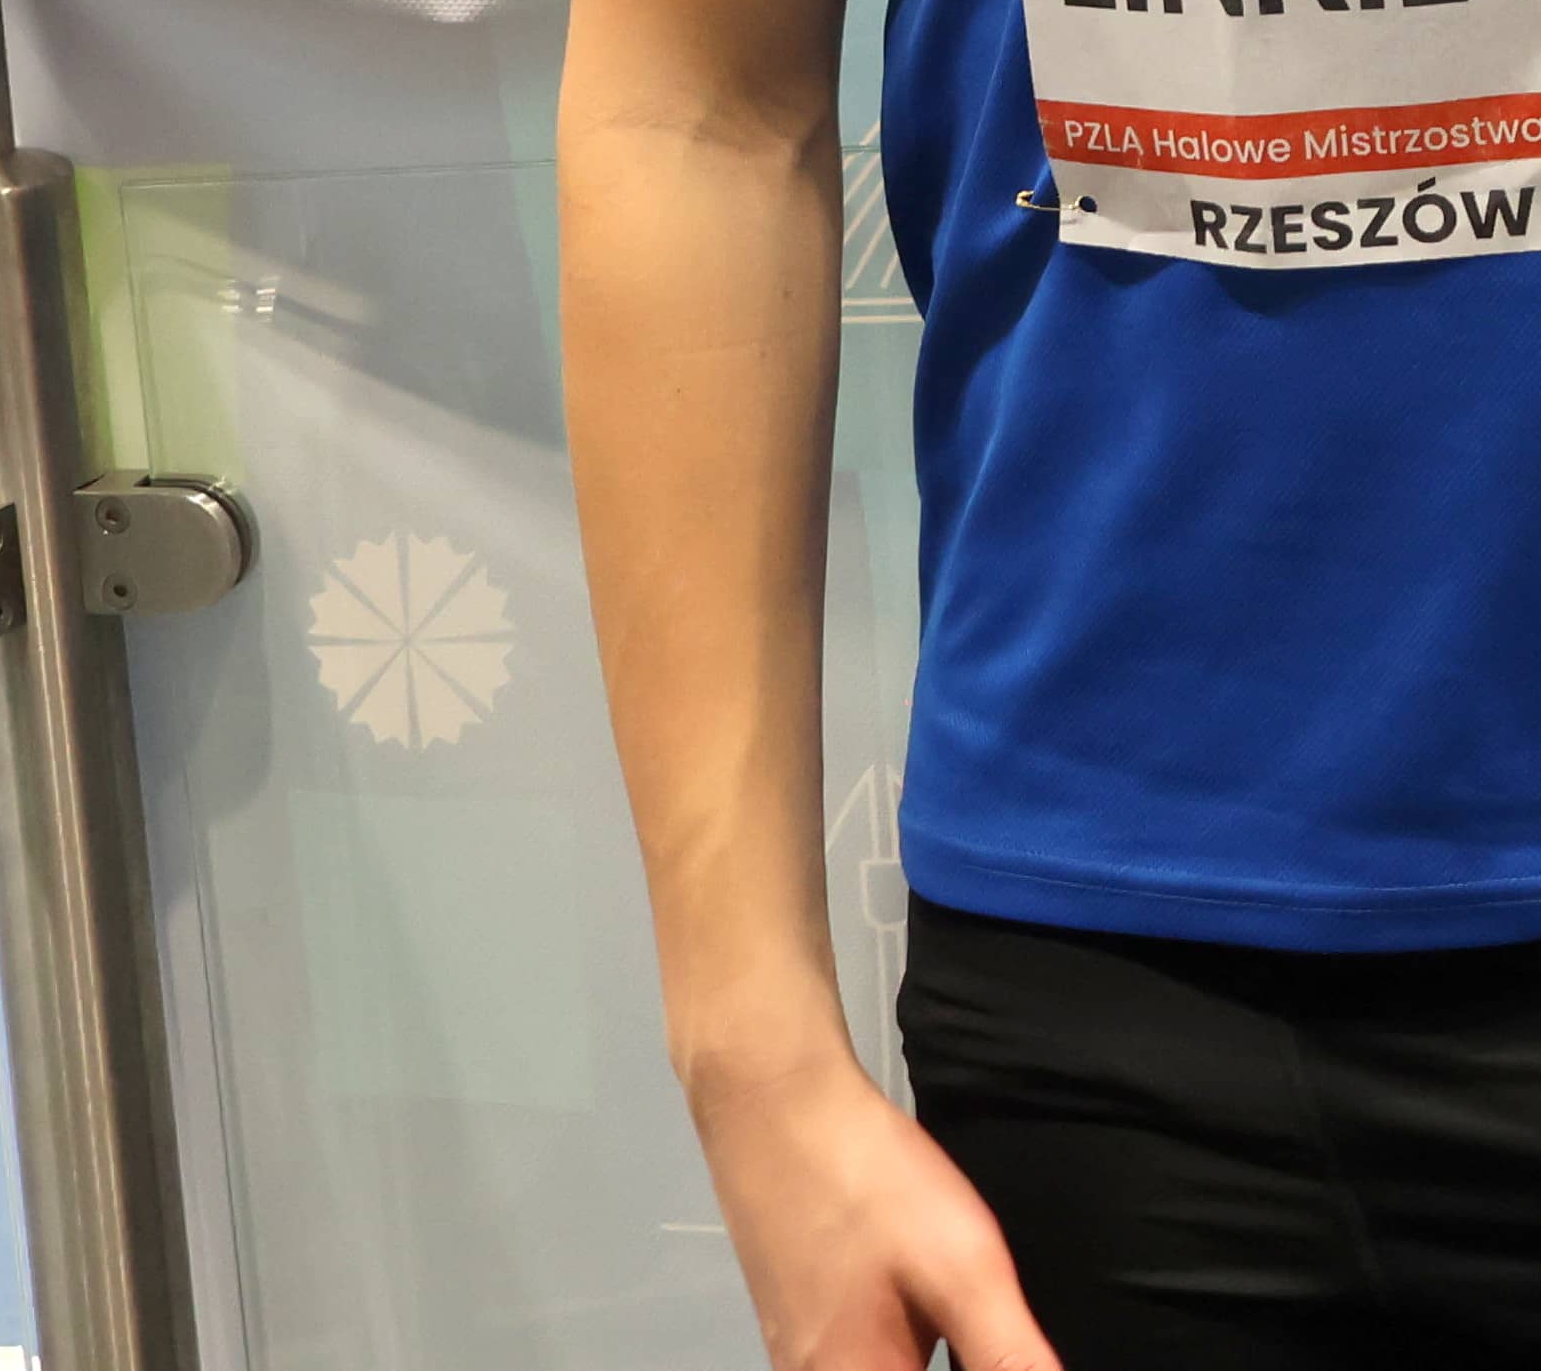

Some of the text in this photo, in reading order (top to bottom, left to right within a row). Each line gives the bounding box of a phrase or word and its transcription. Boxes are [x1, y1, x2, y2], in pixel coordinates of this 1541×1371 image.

[1064, 120, 1144, 155] PZLA
[1153, 128, 1291, 163] Halowe
[1189, 176, 1536, 255] RZESZÓW
